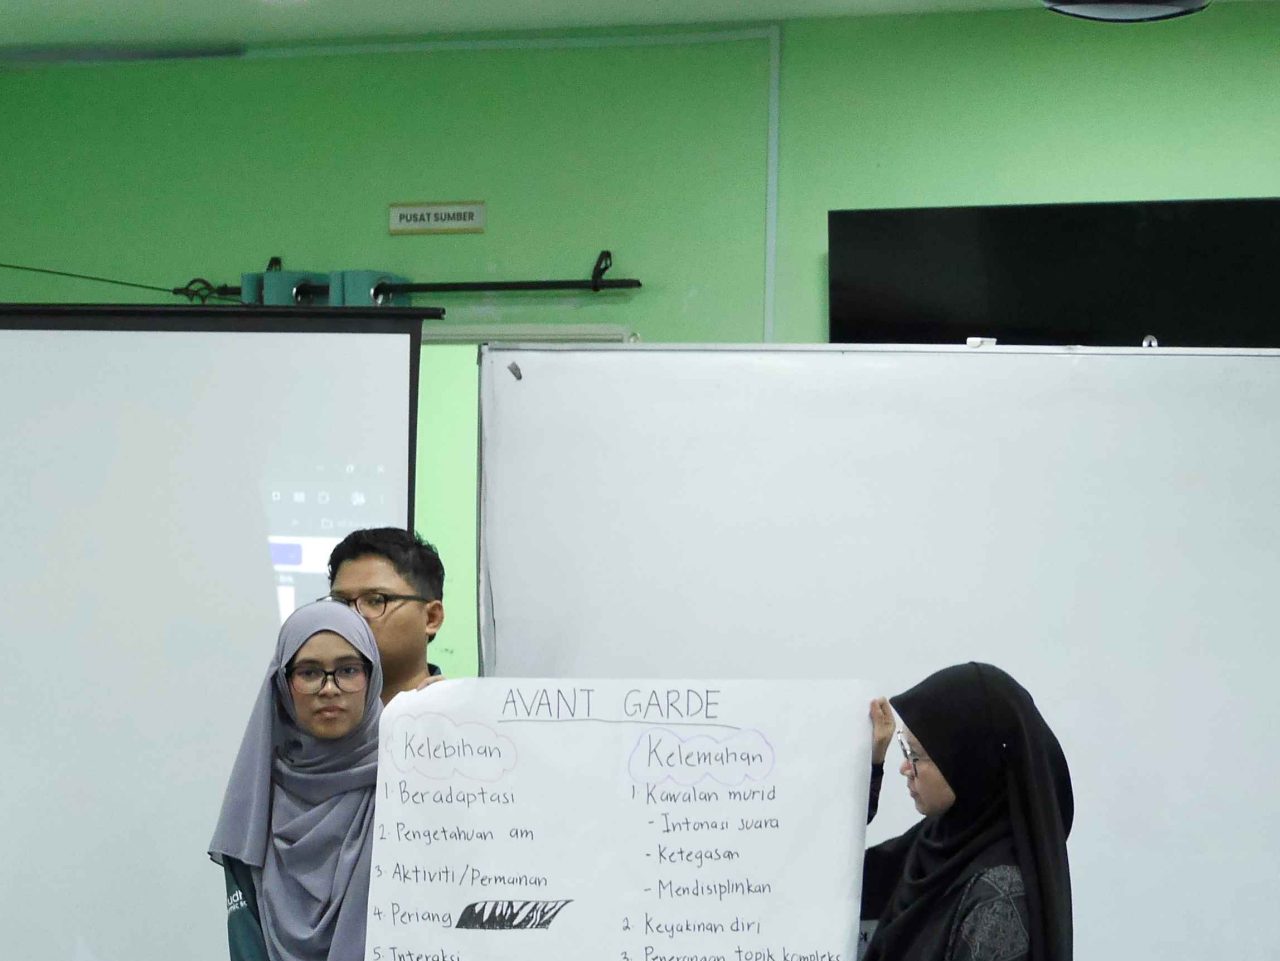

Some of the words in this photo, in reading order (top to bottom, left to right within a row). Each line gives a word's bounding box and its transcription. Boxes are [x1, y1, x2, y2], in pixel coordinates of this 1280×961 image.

[399, 212, 431, 223] PUSAT
[434, 211, 475, 222] SUMBER
[501, 688, 596, 720] AVANT
[623, 688, 721, 720] GARDE
[404, 731, 502, 760] Kelebihan
[648, 733, 763, 768] Kelemahan
[398, 779, 515, 809] Beradaptasi
[645, 782, 719, 805] Kawalan
[728, 785, 777, 802] murid
[396, 821, 495, 846] Pengetahuan
[508, 827, 535, 842] am
[660, 812, 729, 834] Intonasi
[737, 817, 780, 832] suara
[658, 843, 740, 869] Ketegasan
[658, 878, 772, 902] Mendisiplinkan
[390, 901, 453, 929] Periang
[644, 912, 725, 938] Keyakinan
[729, 914, 762, 935] diri
